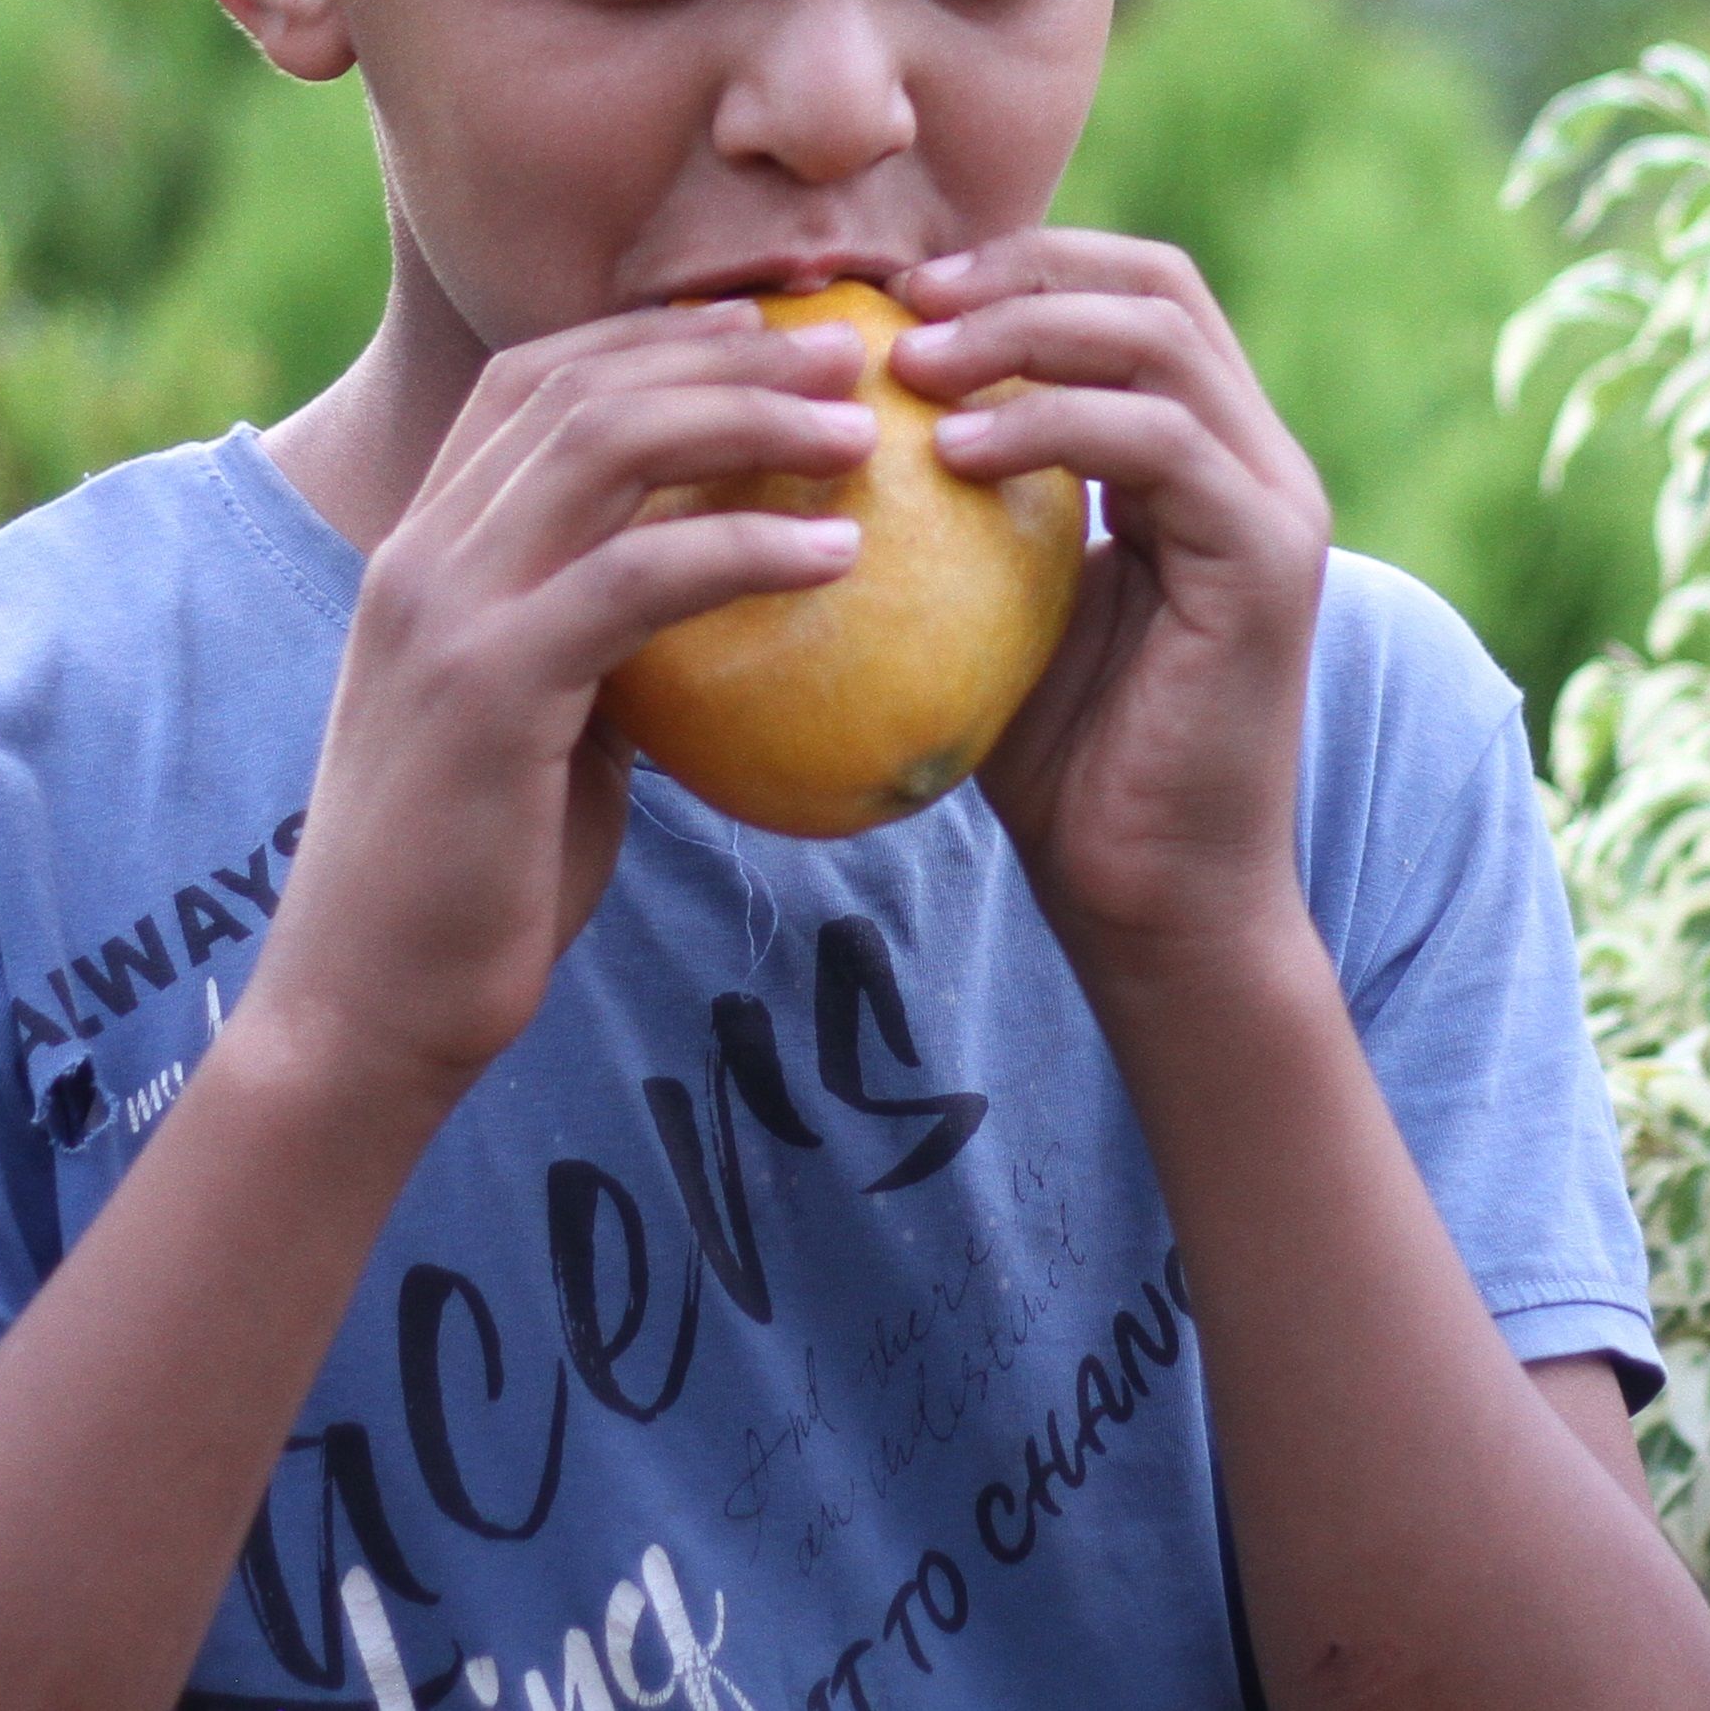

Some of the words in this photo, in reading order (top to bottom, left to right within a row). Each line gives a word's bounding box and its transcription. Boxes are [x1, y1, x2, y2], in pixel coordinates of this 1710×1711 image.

[858, 1235, 993, 1384] there
[882, 1549, 970, 1676] TO
[974, 1243, 1192, 1565] CHAN
